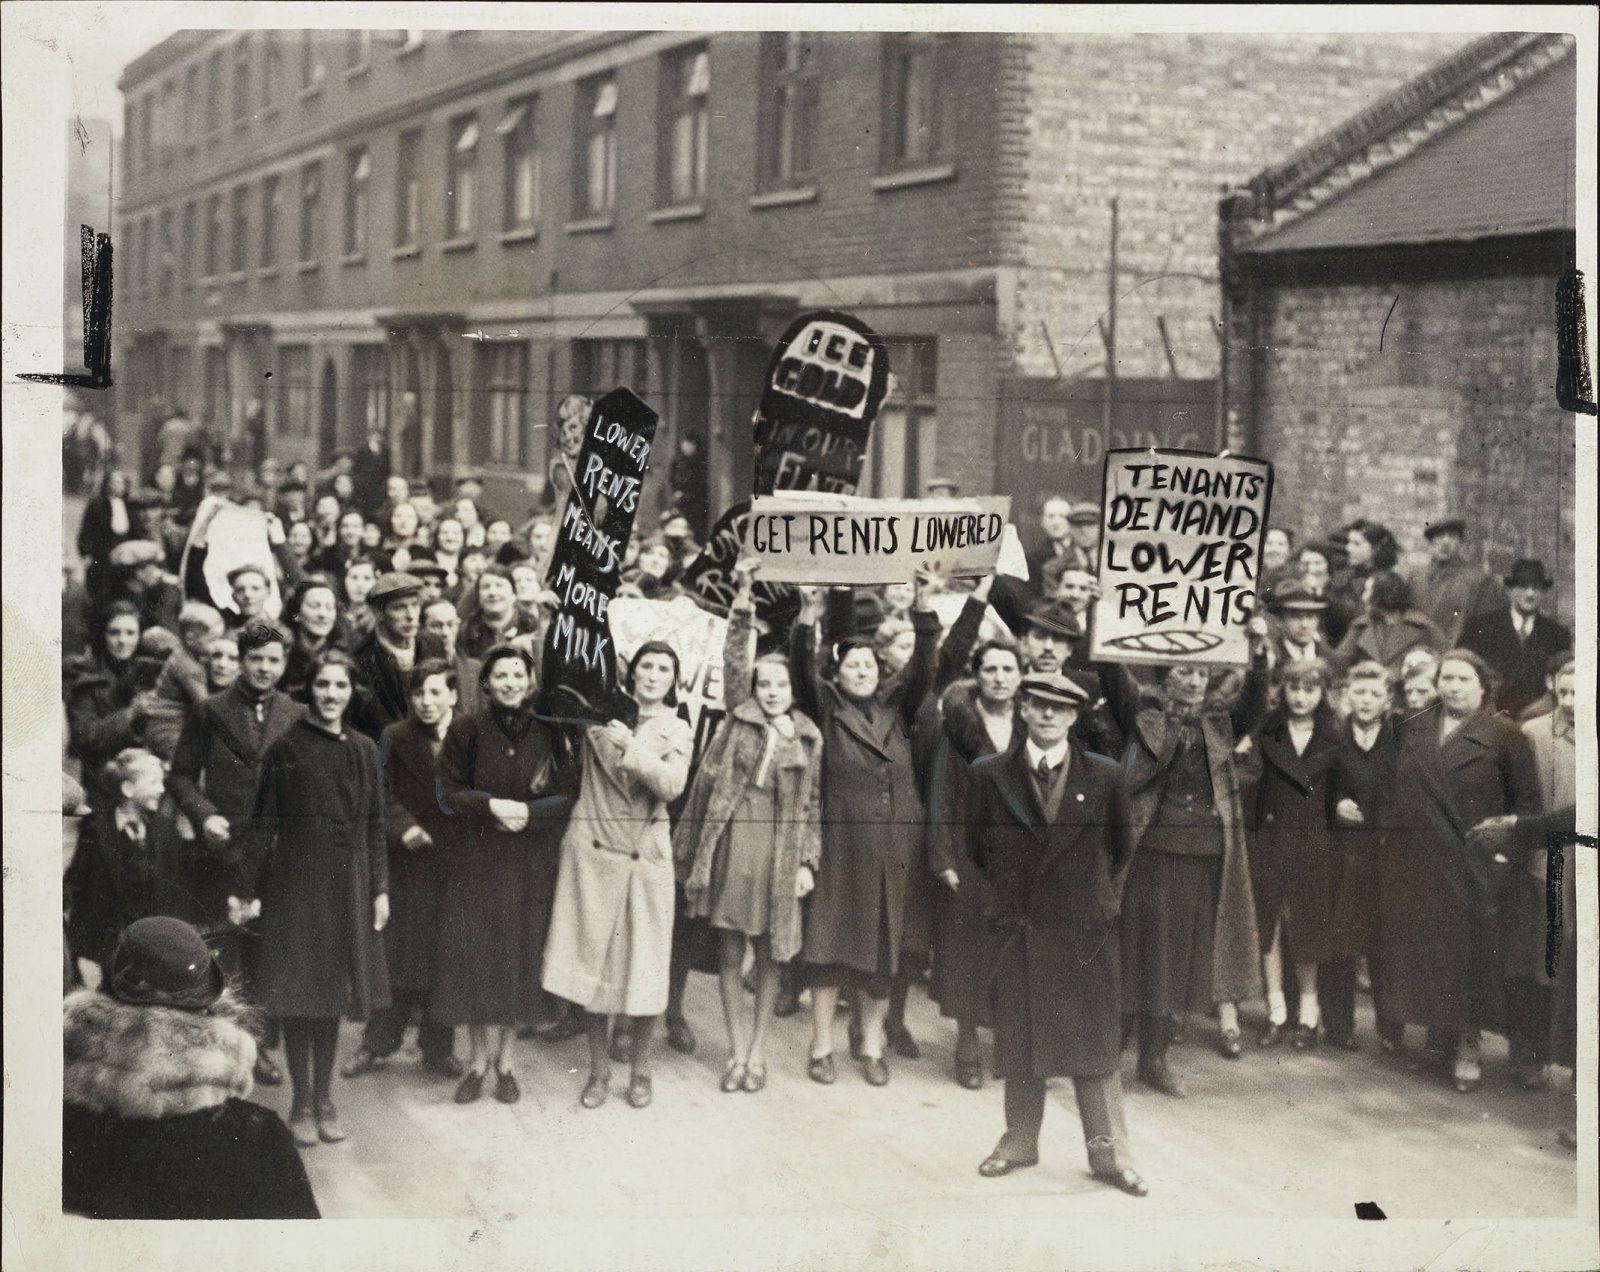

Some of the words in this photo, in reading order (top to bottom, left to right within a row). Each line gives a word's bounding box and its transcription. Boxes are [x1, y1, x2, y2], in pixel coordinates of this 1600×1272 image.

[807, 328, 870, 371] ICE
[583, 453, 640, 513] RENTS
[1124, 464, 1264, 501] TENANTS
[563, 502, 621, 573] MEANS
[753, 514, 796, 554] GET
[809, 515, 901, 555] RENTS
[910, 513, 1002, 553] LOWERED
[1108, 493, 1259, 540] DEMAND
[1107, 540, 1254, 584] LOWER
[556, 562, 609, 623] MORE
[1115, 581, 1255, 627] RENTS
[553, 612, 608, 679] MILK
